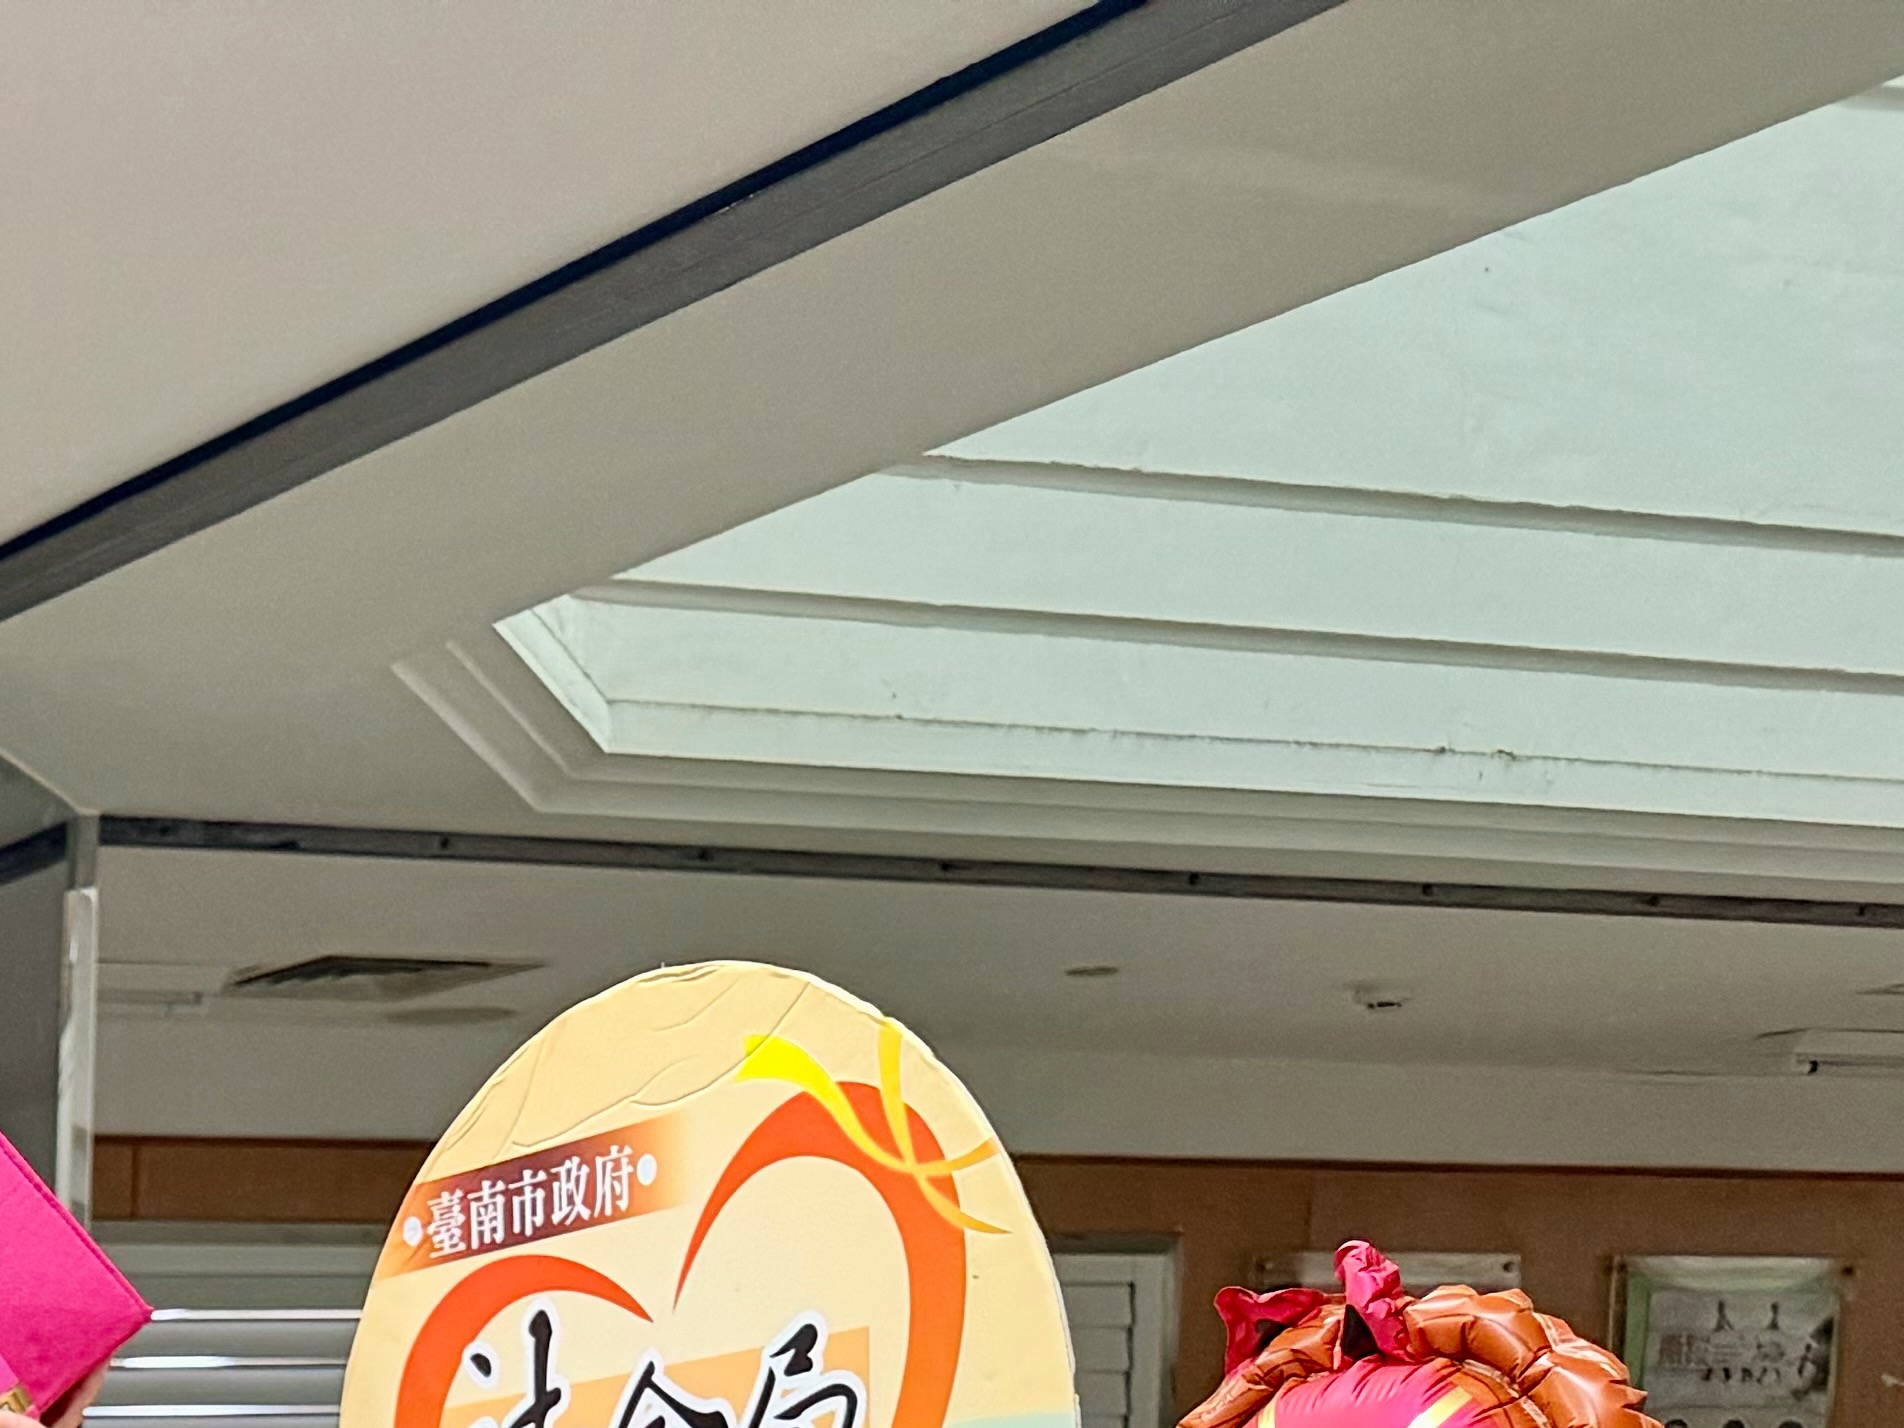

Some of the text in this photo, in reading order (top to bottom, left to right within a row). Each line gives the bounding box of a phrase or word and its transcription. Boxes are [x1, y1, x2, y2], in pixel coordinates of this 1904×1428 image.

[426, 1145, 635, 1260] 臺南市政府
